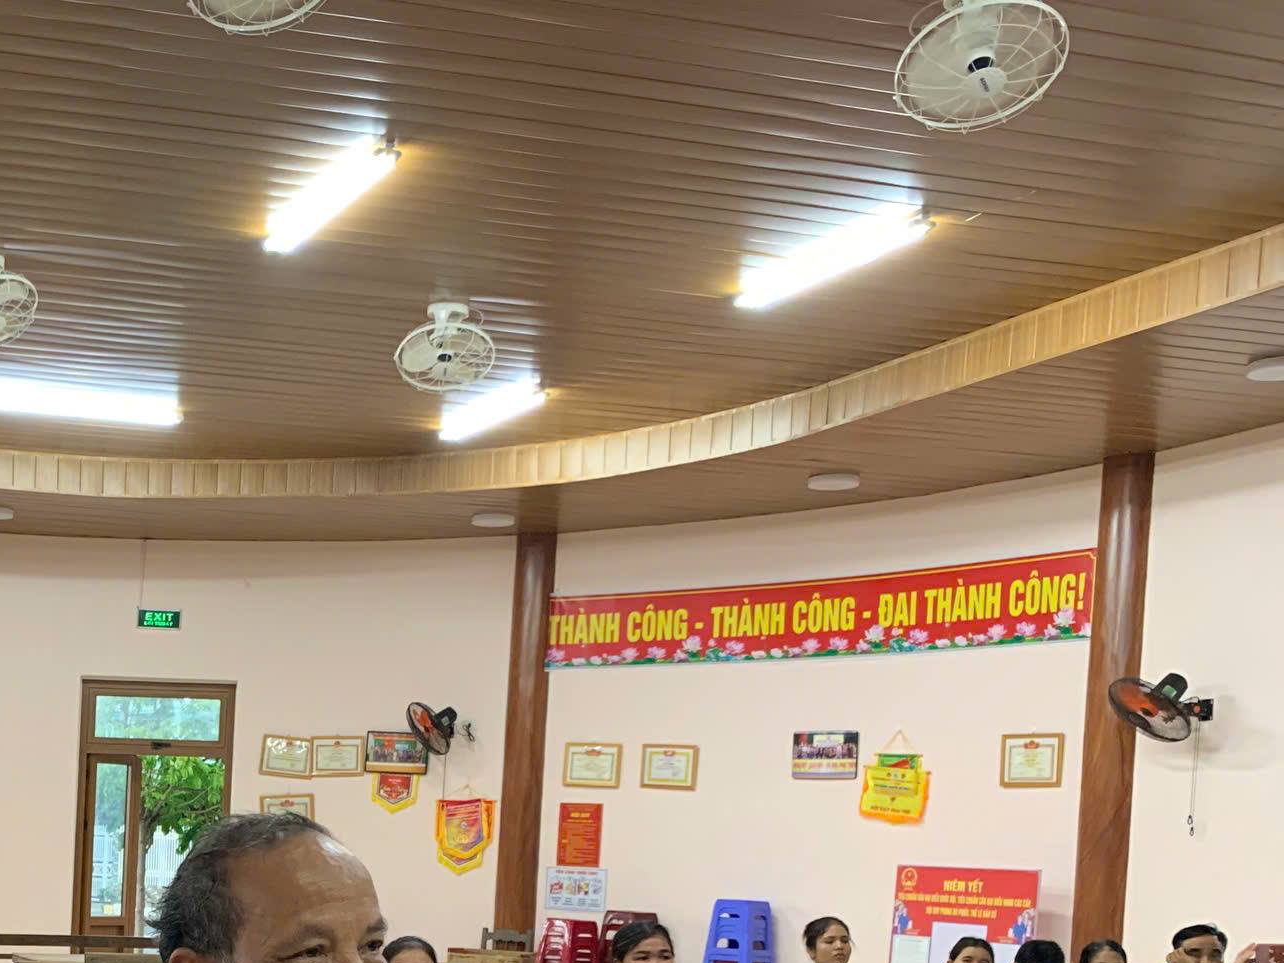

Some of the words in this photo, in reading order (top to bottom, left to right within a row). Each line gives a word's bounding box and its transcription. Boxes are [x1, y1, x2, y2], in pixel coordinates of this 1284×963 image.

[145, 612, 174, 621] EXIT
[549, 608, 620, 645] THÀNH
[627, 604, 689, 642] CÔNG
[711, 598, 786, 639] THÀNH
[792, 592, 855, 634] CÔNG
[924, 578, 1002, 624] THÀNH
[1009, 570, 1086, 617] CÔNG!
